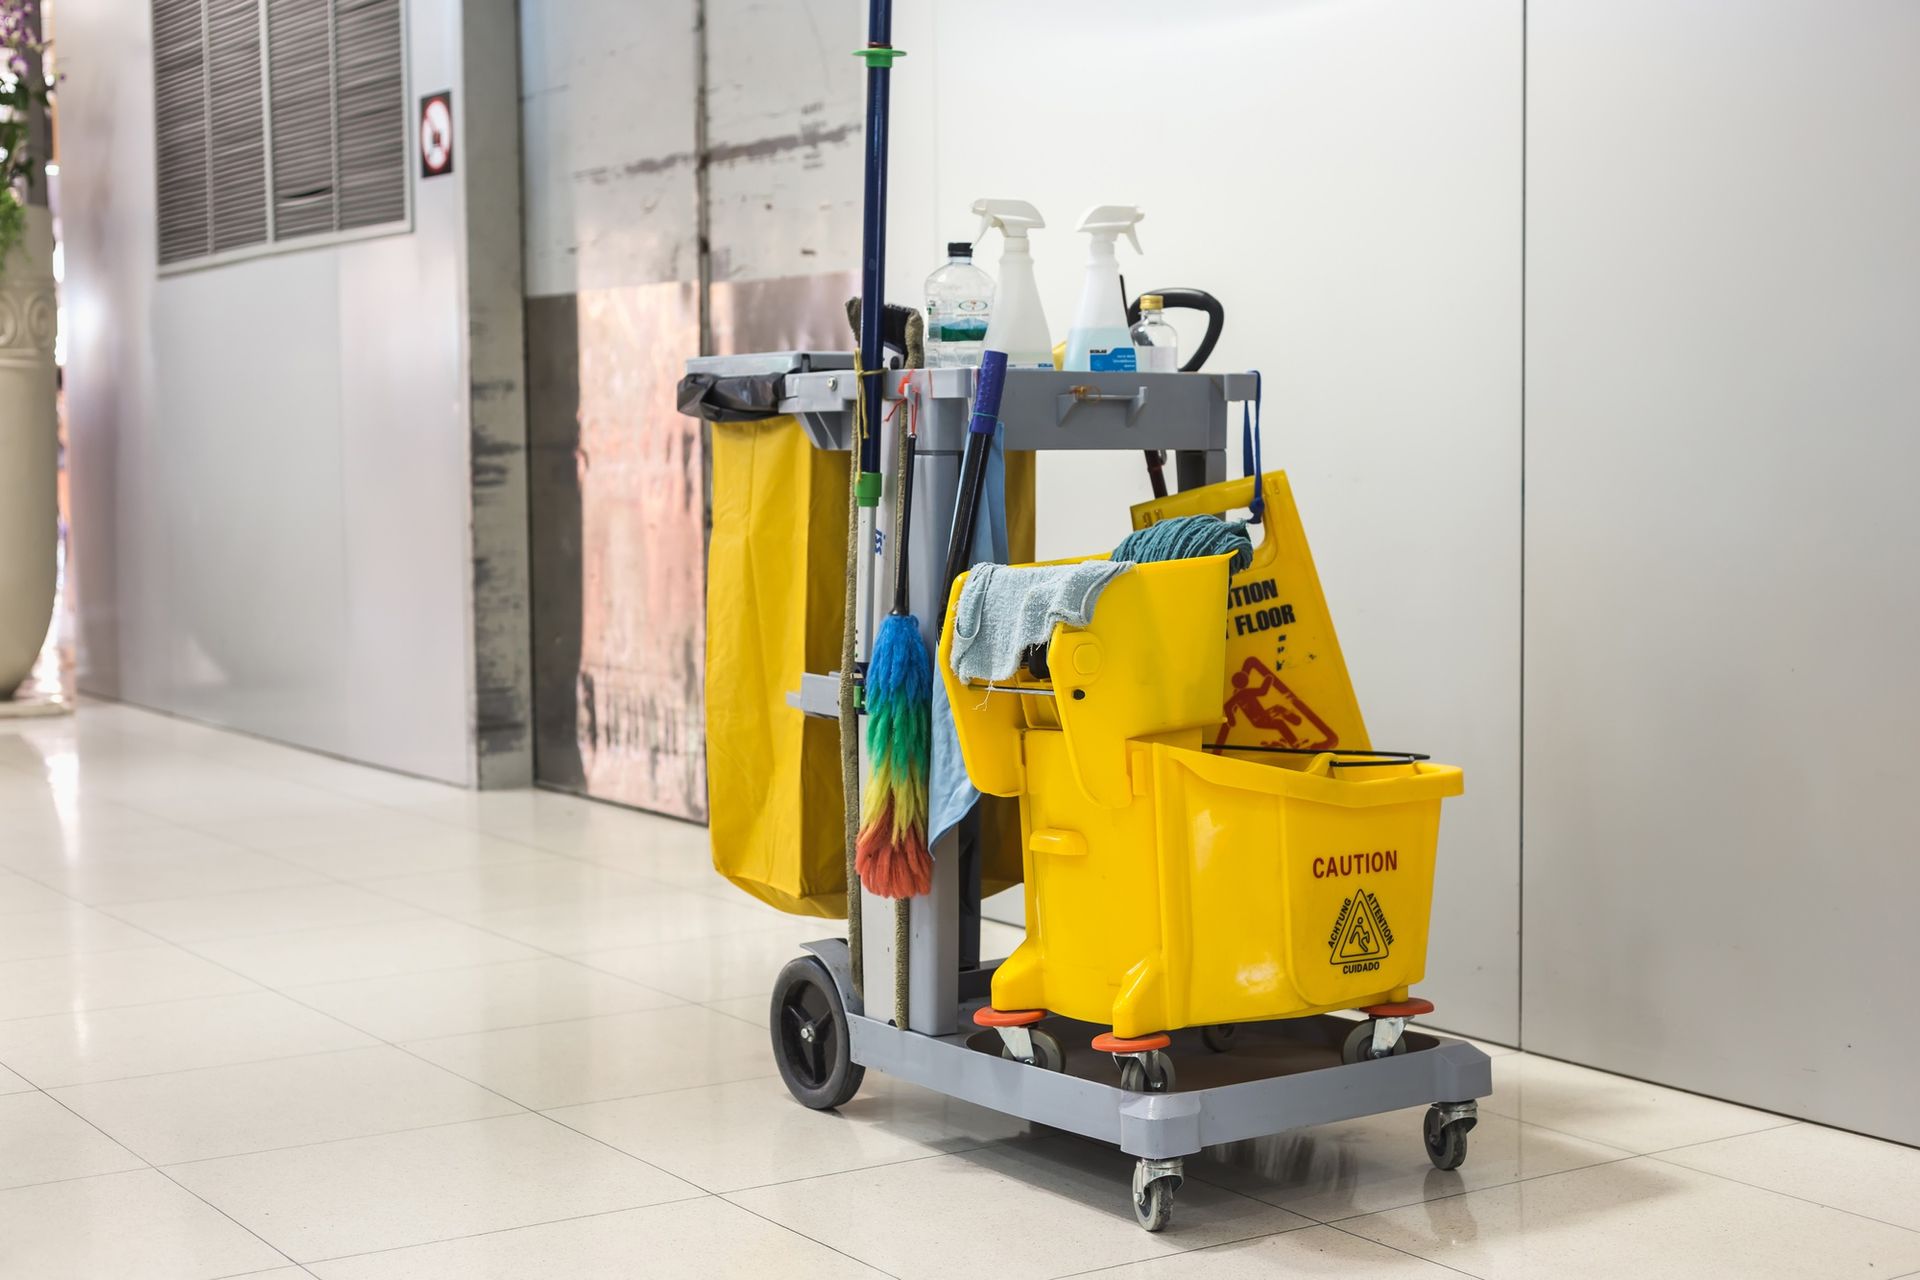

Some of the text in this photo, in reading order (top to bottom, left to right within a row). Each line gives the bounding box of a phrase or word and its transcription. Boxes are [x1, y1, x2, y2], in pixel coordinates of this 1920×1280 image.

[1228, 578, 1278, 610] TION
[1234, 604, 1296, 636] FLOOR
[1312, 850, 1398, 879] CAUTION
[1327, 897, 1352, 949] ACHTUNG
[1366, 892, 1394, 946] ATTENTION
[1342, 961, 1380, 975] CUIDADO
